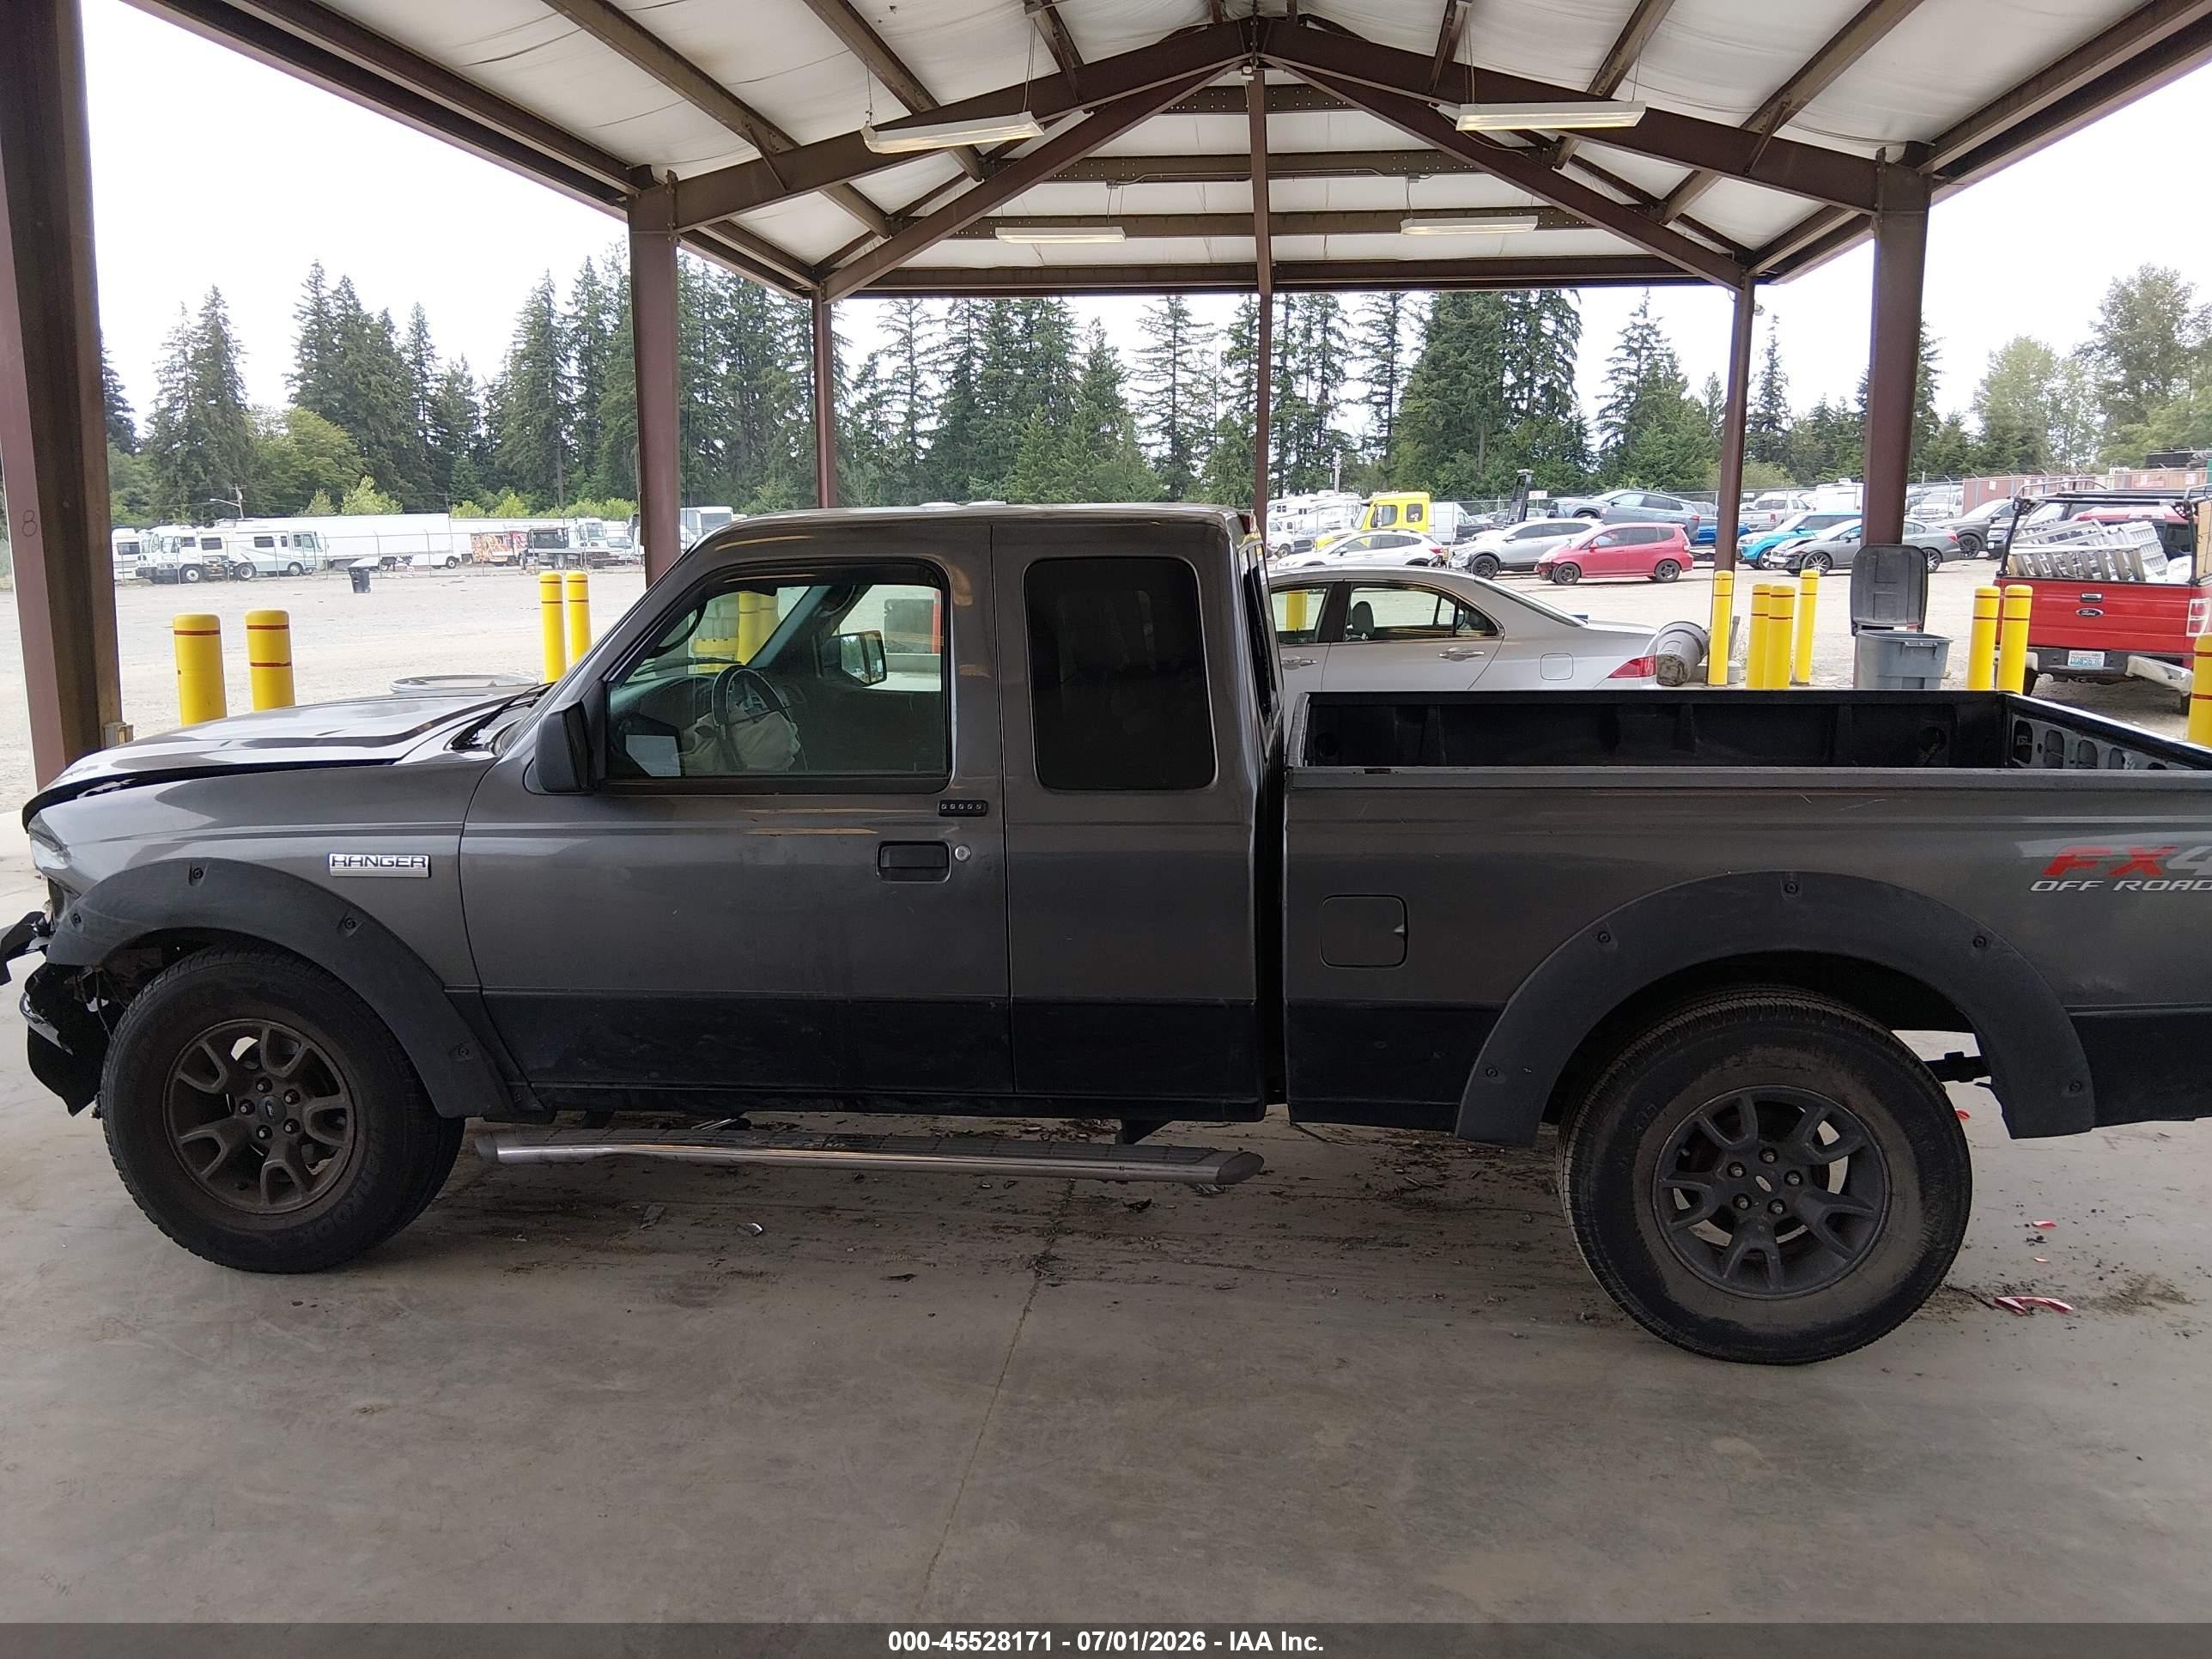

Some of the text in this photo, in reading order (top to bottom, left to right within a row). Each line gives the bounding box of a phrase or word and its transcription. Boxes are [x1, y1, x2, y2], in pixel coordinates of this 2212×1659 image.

[21, 509, 38, 538] 8
[331, 856, 427, 868] RANGER
[2042, 845, 2212, 877] FX4
[2031, 879, 2105, 891] OFF
